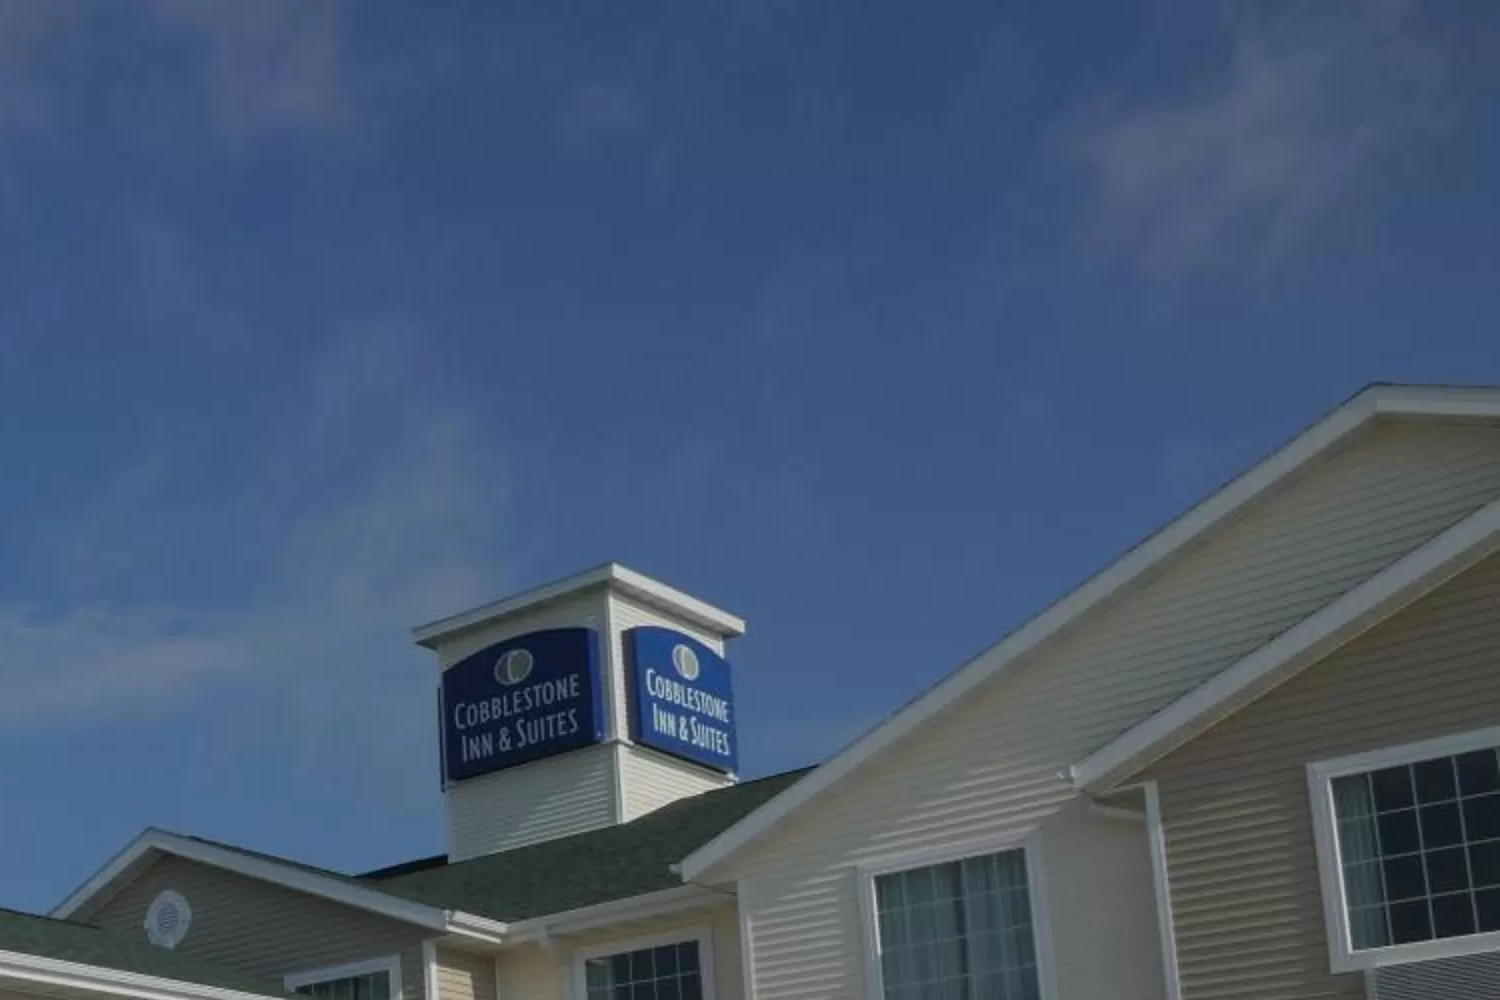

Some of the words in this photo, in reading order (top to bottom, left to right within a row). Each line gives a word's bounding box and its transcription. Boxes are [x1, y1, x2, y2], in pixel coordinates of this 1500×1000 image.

[455, 673, 580, 729] COBBLESTONE
[646, 668, 729, 723] COBBLESTONE
[461, 732, 493, 764] INN
[499, 726, 512, 752] &
[515, 708, 579, 748] SUITES
[653, 702, 676, 737] INN
[680, 716, 688, 742] &
[690, 716, 730, 756] SUITES
